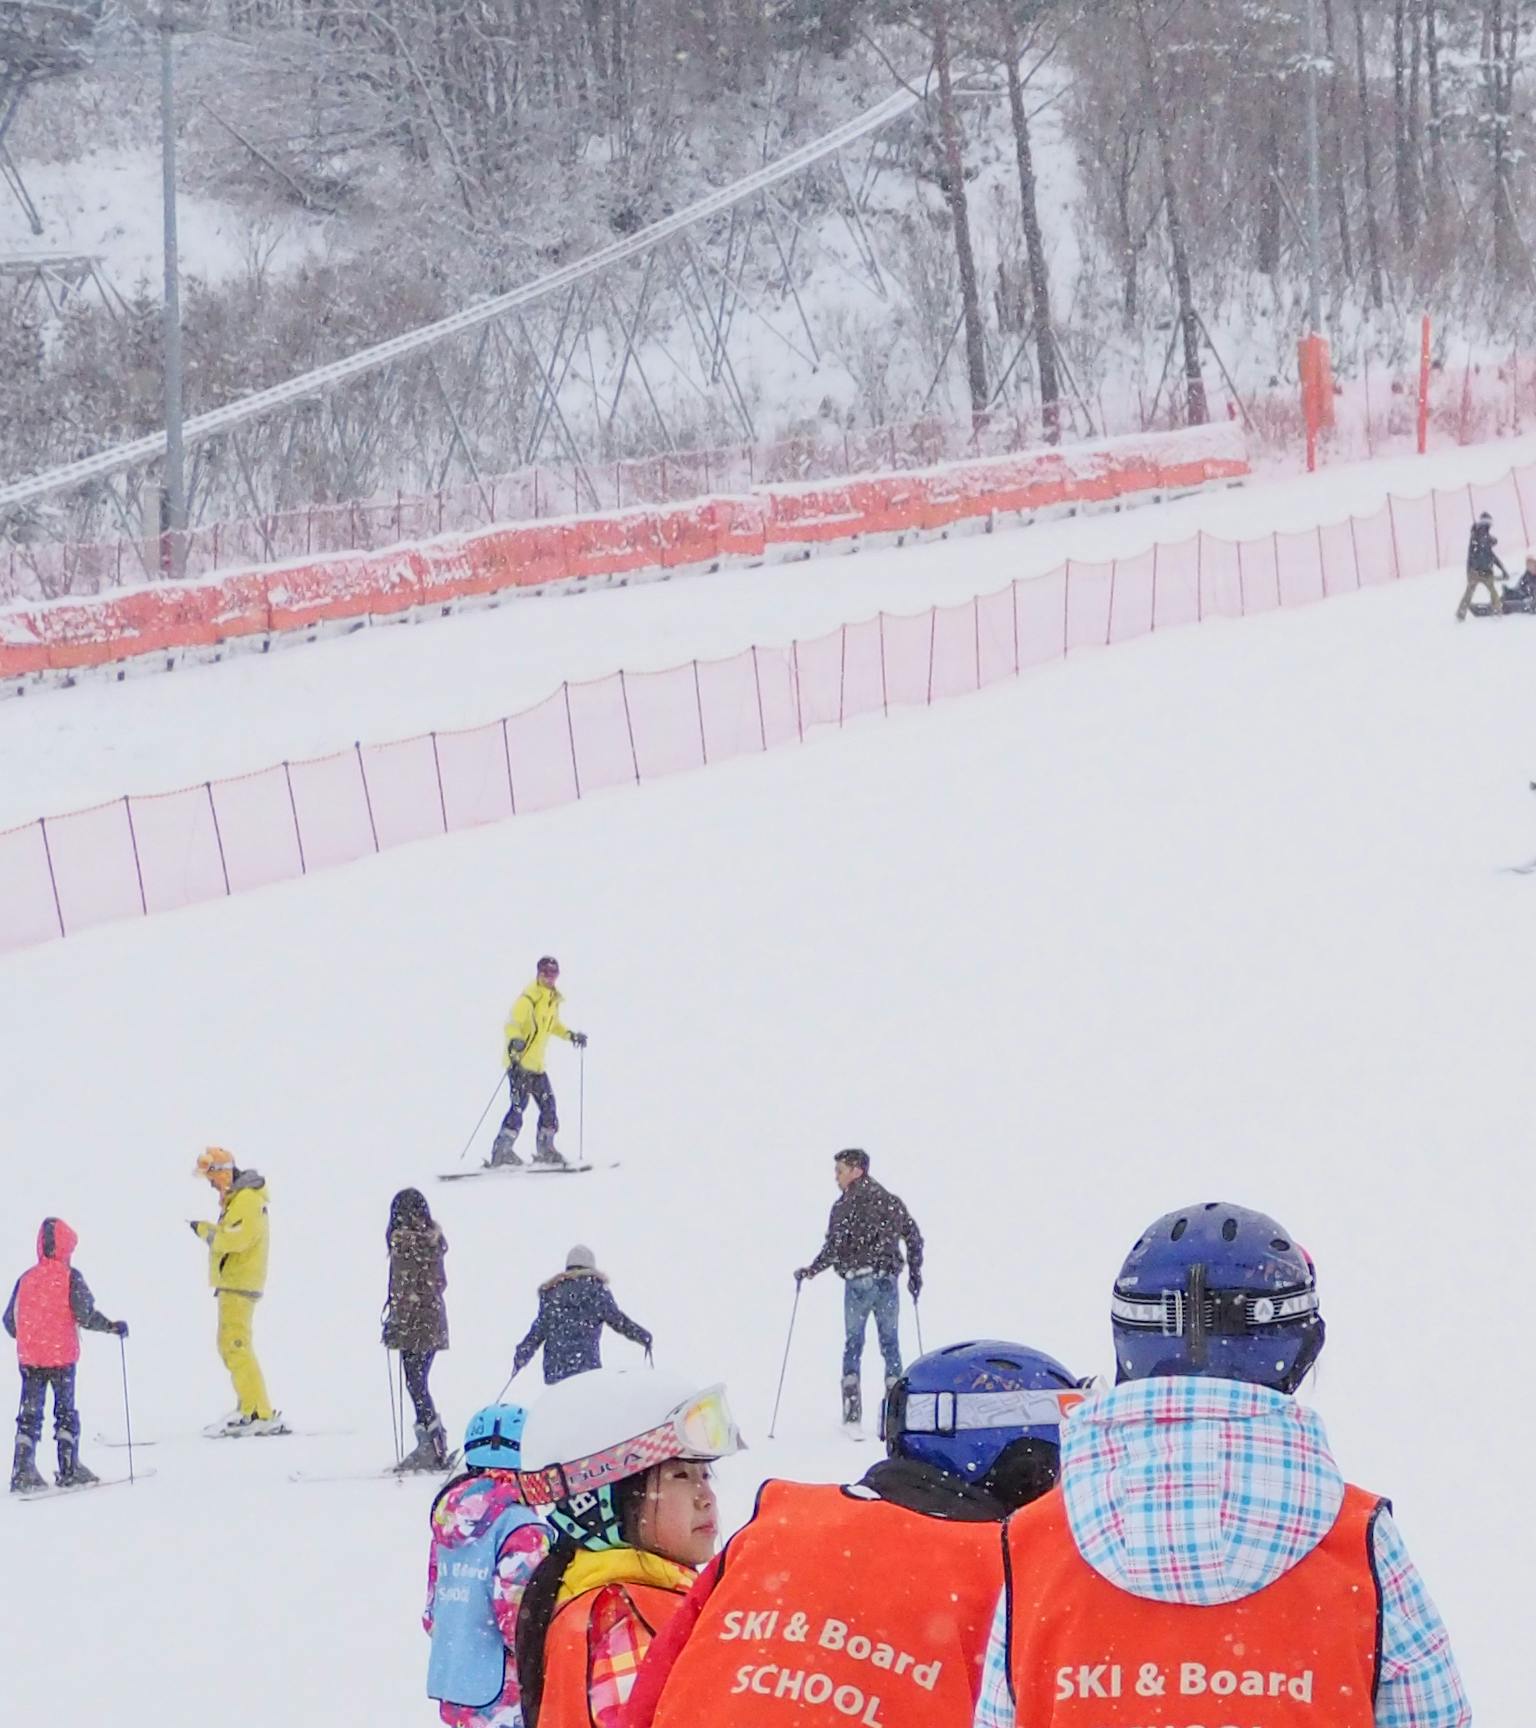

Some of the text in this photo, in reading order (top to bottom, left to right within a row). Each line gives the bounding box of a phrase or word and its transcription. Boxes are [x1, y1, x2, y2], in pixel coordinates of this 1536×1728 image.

[718, 1610, 942, 1691] SKI & Board
[1056, 1662, 1313, 1703] SKI & Board
